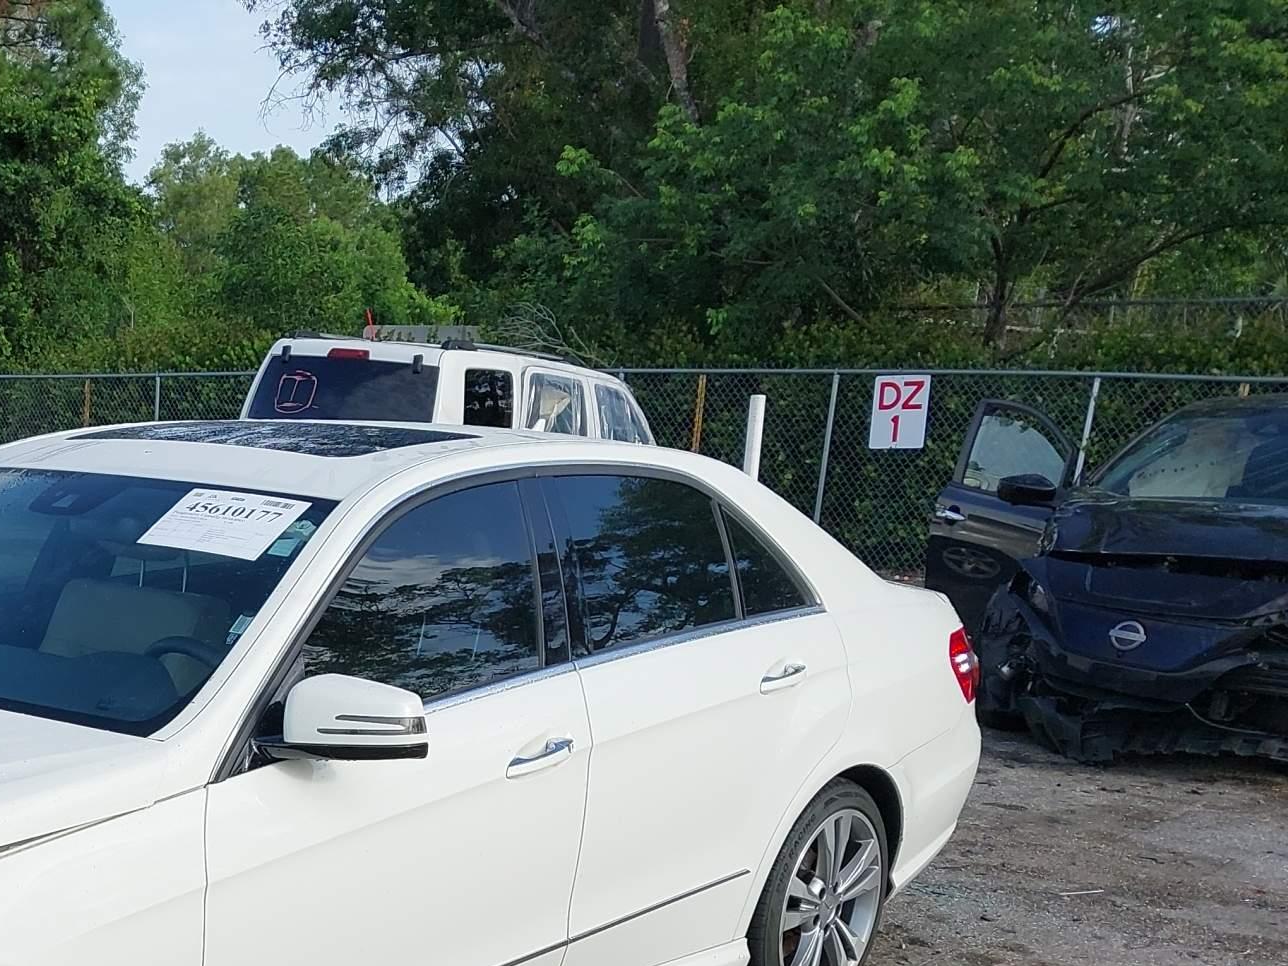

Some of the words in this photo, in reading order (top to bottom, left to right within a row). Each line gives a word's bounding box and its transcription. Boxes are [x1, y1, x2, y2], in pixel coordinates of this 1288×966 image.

[878, 380, 924, 411] DZ
[890, 414, 901, 443] 1
[186, 501, 283, 523] 45610177
